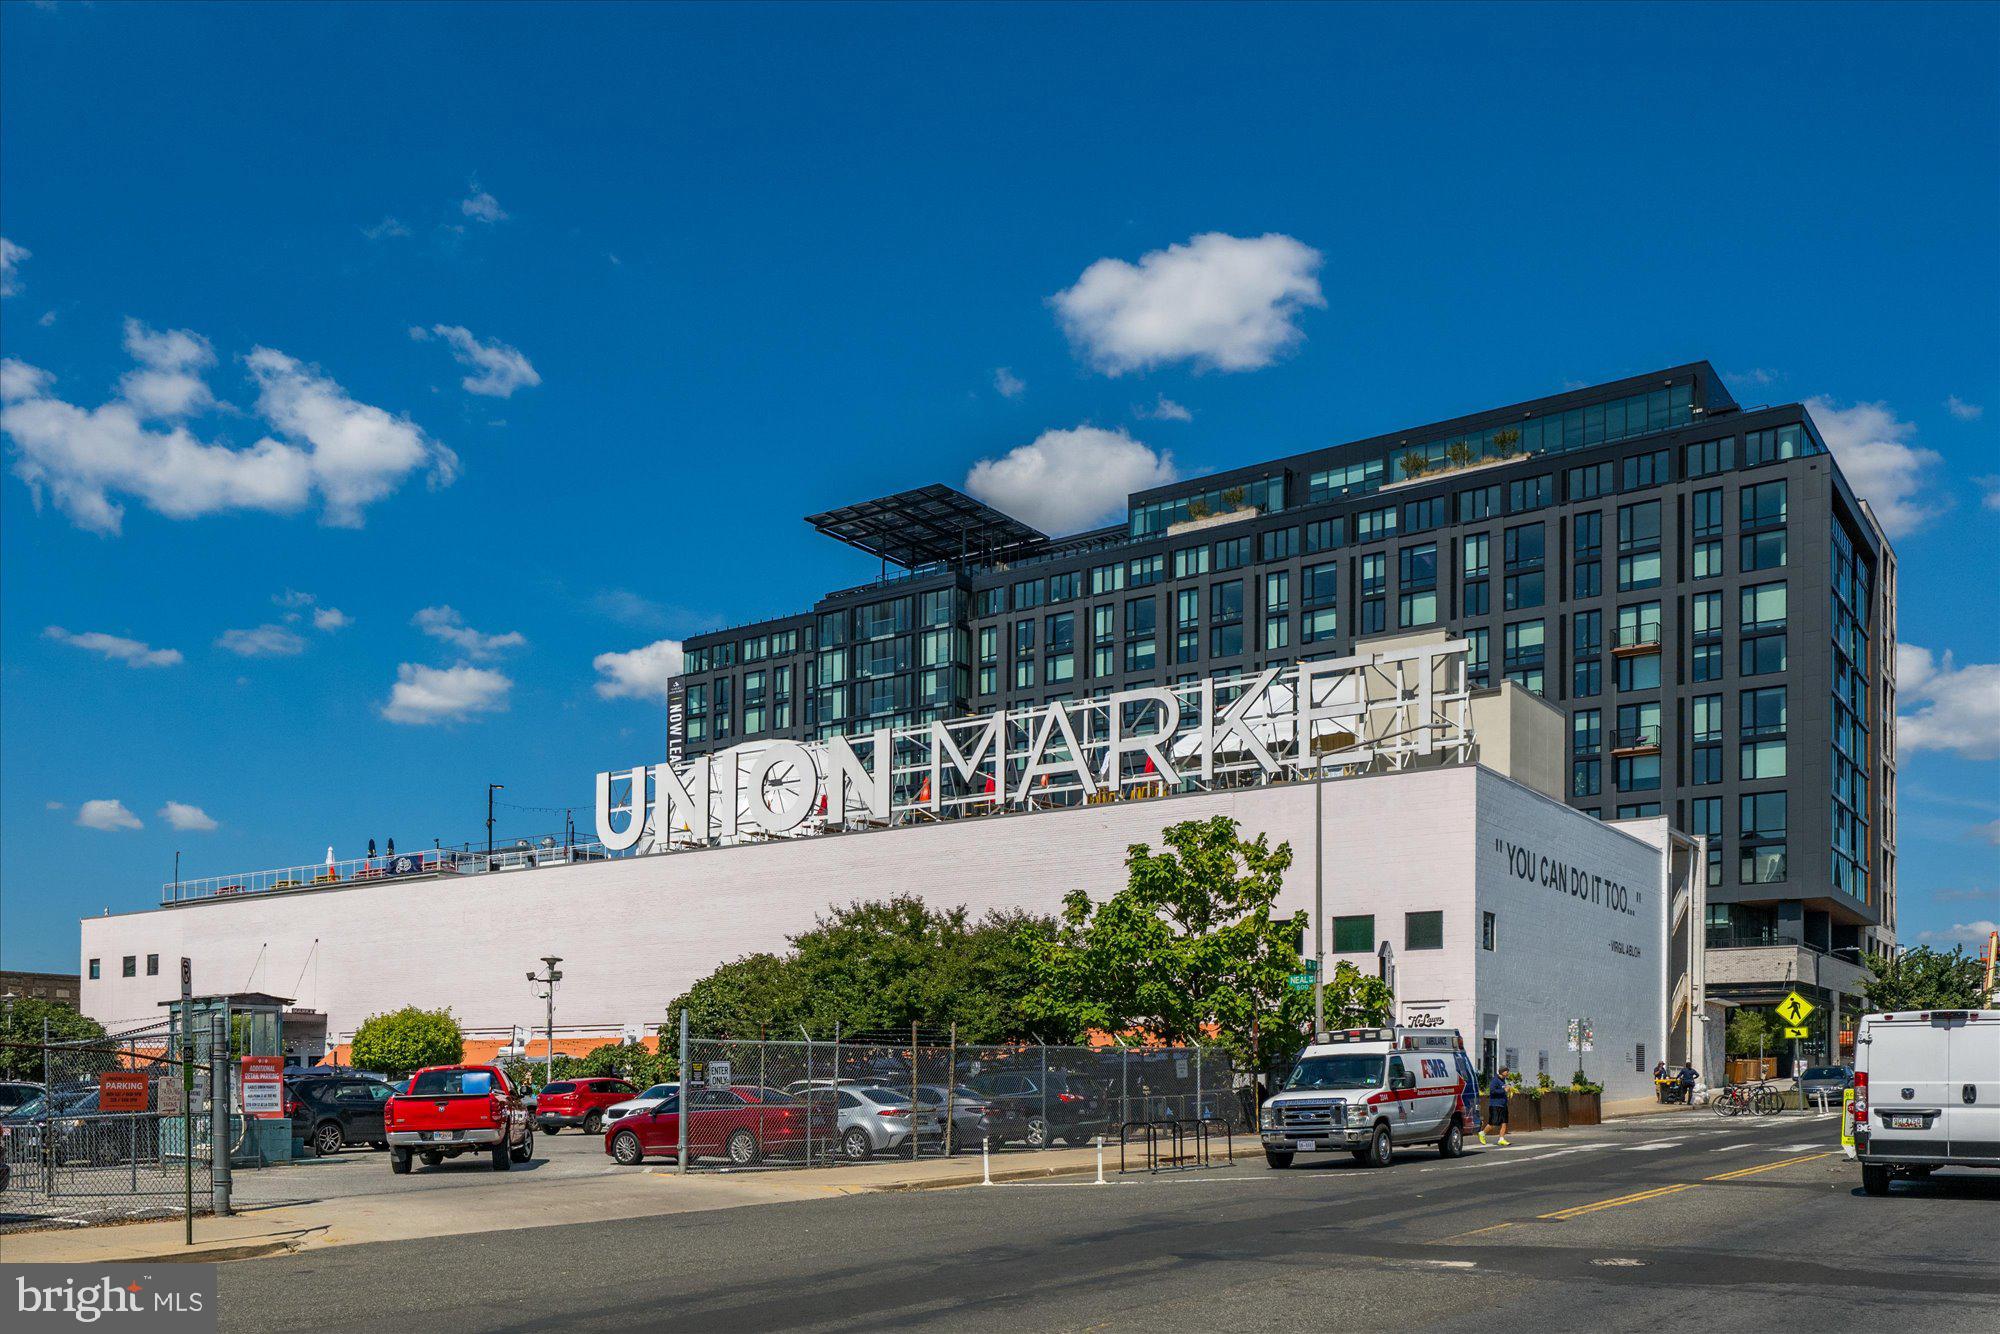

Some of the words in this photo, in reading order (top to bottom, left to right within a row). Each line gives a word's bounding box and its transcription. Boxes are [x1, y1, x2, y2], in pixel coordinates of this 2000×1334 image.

[670, 704, 682, 735] NOW
[596, 728, 892, 850] UNION
[931, 638, 1470, 812] MARKET
[1540, 856, 1567, 893] CAN
[1571, 867, 1588, 900] DO
[1591, 874, 1602, 905] IT
[1290, 975, 1308, 984] NEAL
[1426, 1036, 1447, 1046] AMBULANCE
[711, 1066, 729, 1075] ENTER
[1421, 1059, 1449, 1079] AMR
[712, 1076, 729, 1085] ONLY
[105, 1082, 143, 1090] PARKING
